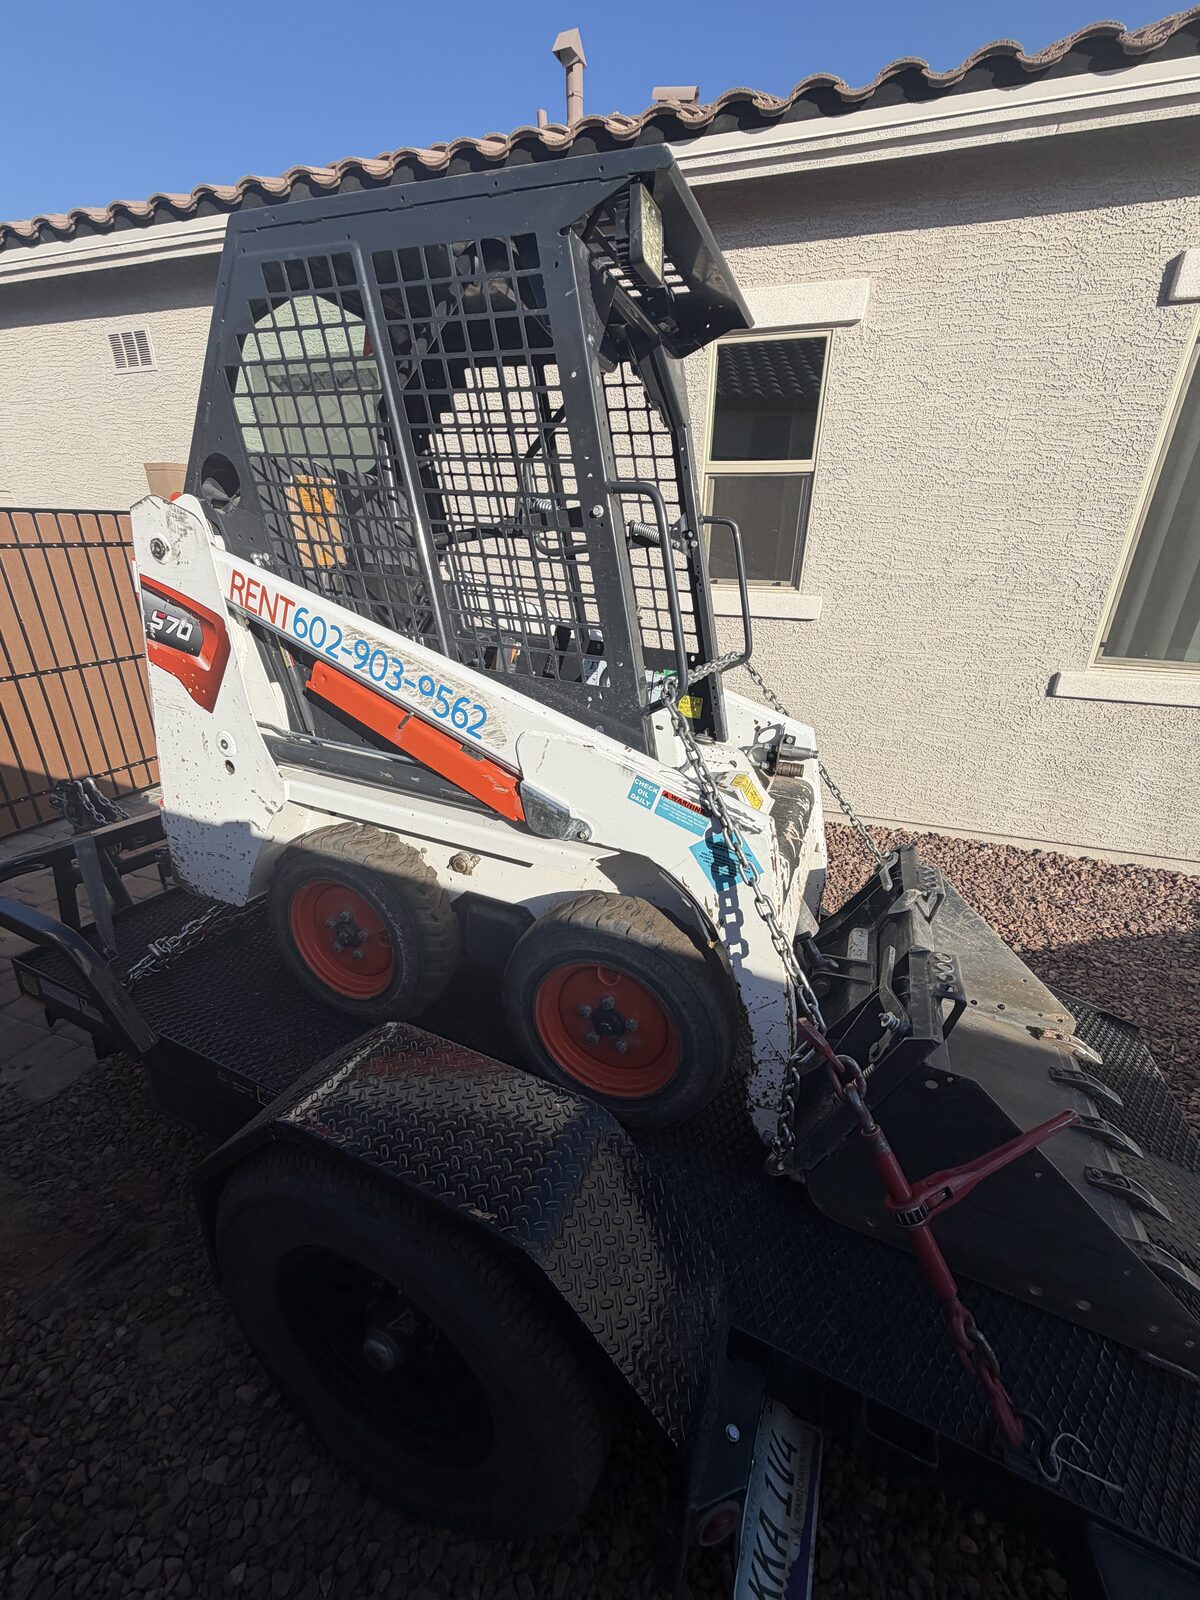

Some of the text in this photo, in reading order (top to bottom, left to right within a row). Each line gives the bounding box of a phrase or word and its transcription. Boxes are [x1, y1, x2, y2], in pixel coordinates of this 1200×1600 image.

[150, 610, 193, 642] S70
[229, 569, 488, 740] RENT 602-903-9562
[634, 778, 659, 794] CHECK
[637, 788, 649, 798] OIL
[630, 793, 652, 807] DAILY
